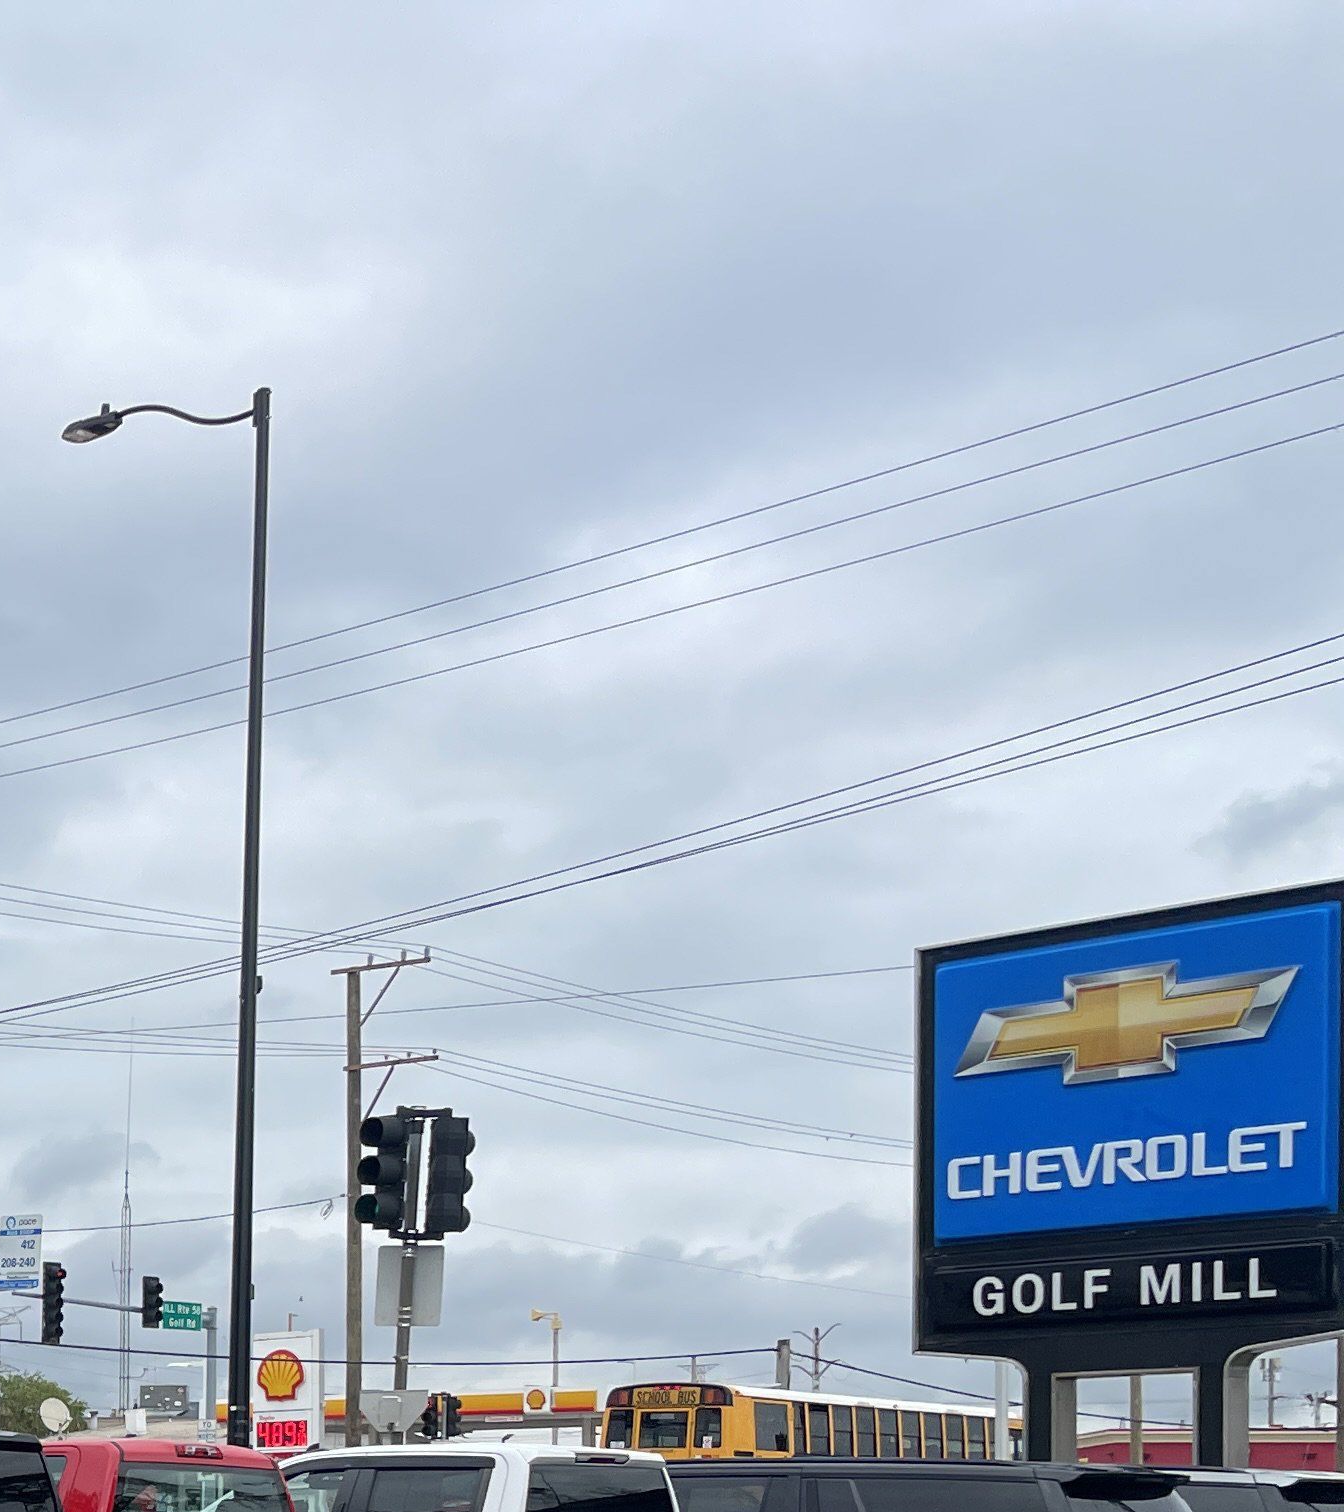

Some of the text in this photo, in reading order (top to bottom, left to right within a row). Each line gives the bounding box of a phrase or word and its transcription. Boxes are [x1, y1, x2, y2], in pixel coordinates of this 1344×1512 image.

[947, 1121, 1308, 1200] CHEVROLET
[21, 1239, 36, 1249] 412
[1, 1257, 36, 1268] 208-240
[972, 1257, 1278, 1317] GOLF MILL
[168, 1317, 196, 1329] Golf Rd
[635, 1389, 697, 1405] SCHOOL BUS
